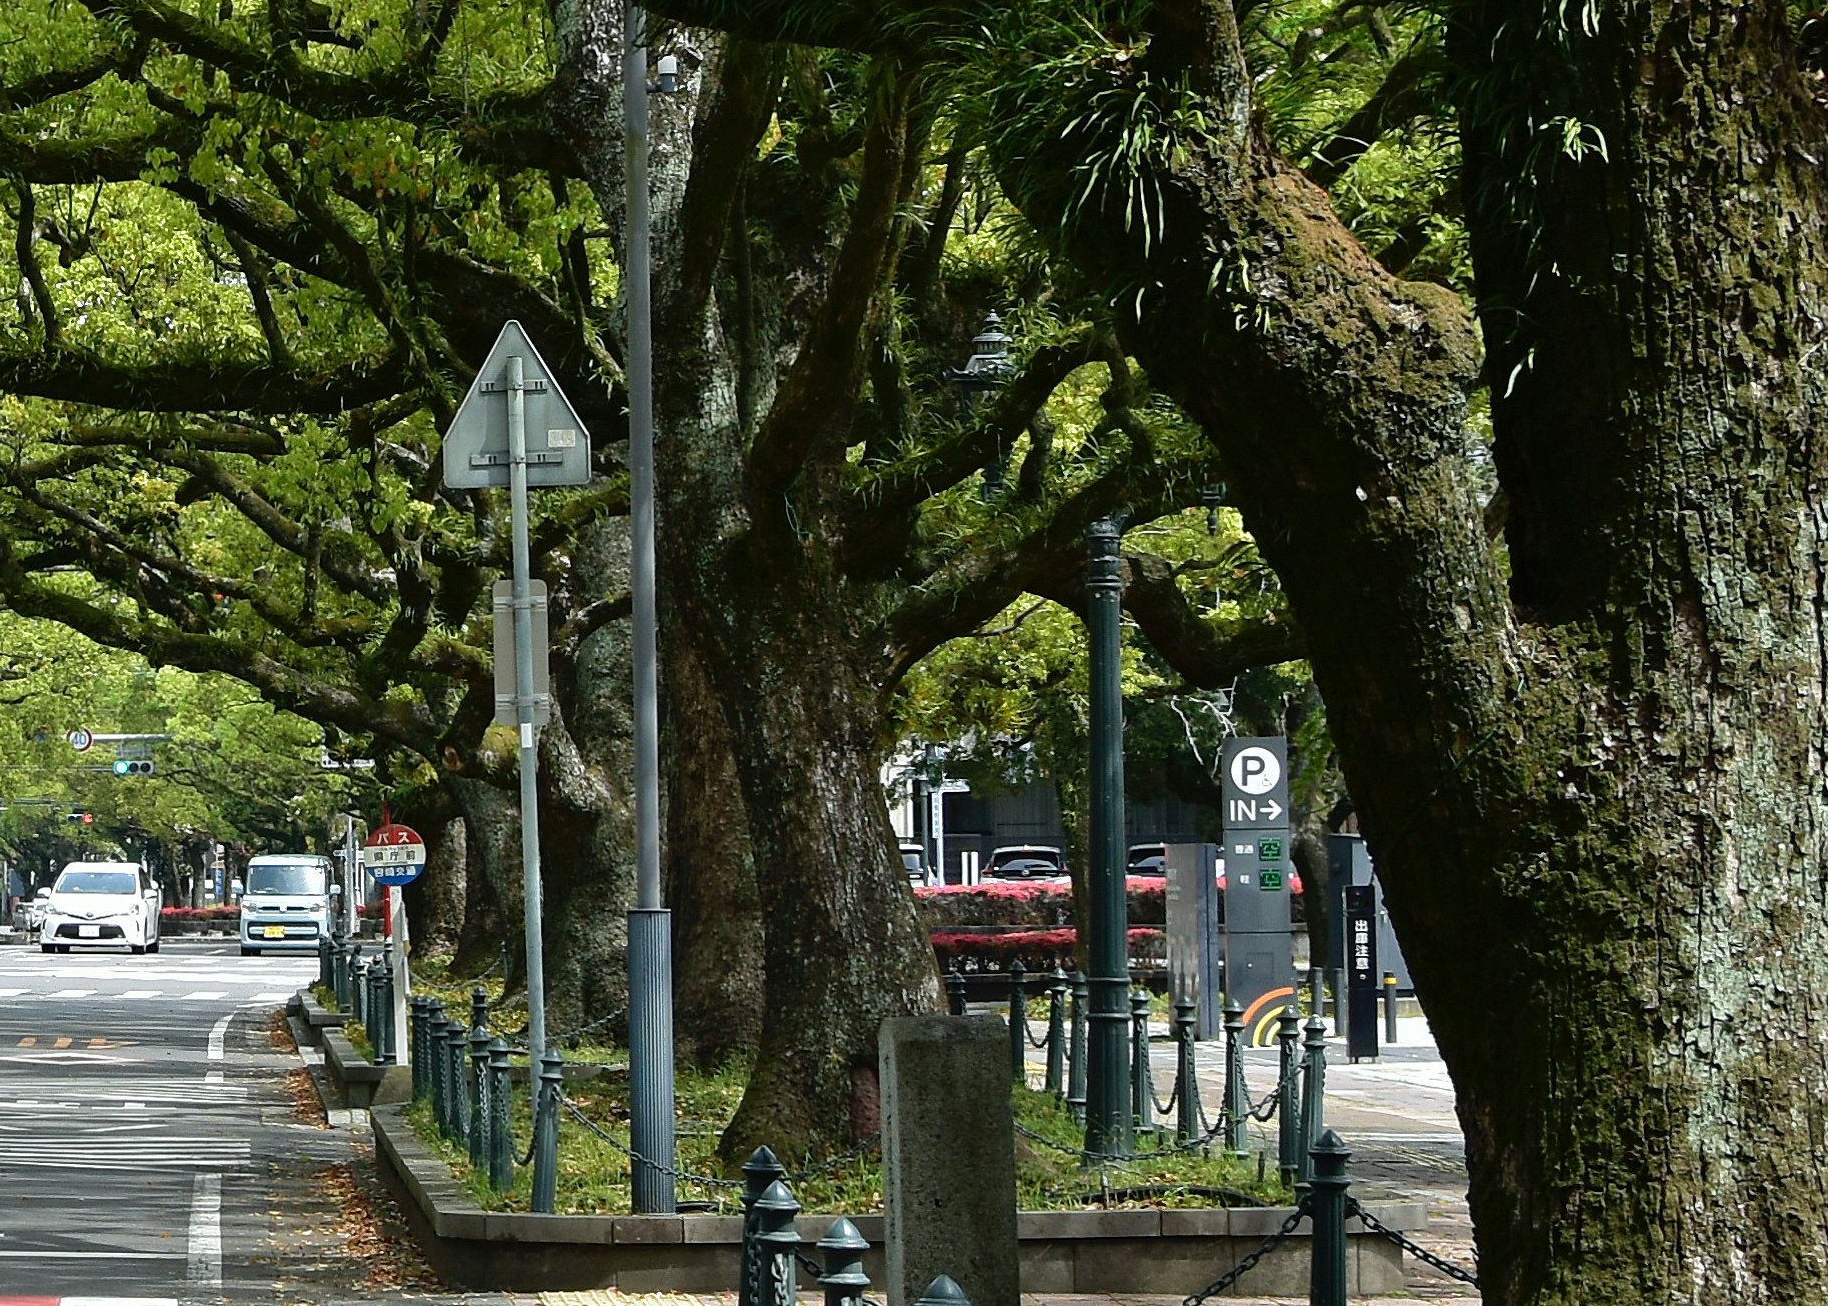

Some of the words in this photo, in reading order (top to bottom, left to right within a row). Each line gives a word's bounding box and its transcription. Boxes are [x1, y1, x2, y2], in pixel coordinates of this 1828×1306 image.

[72, 733, 86, 745] 40
[1241, 756, 1265, 786] P
[1230, 799, 1256, 822] IN
[377, 831, 410, 845] バス
[374, 850, 416, 862] 県庁前
